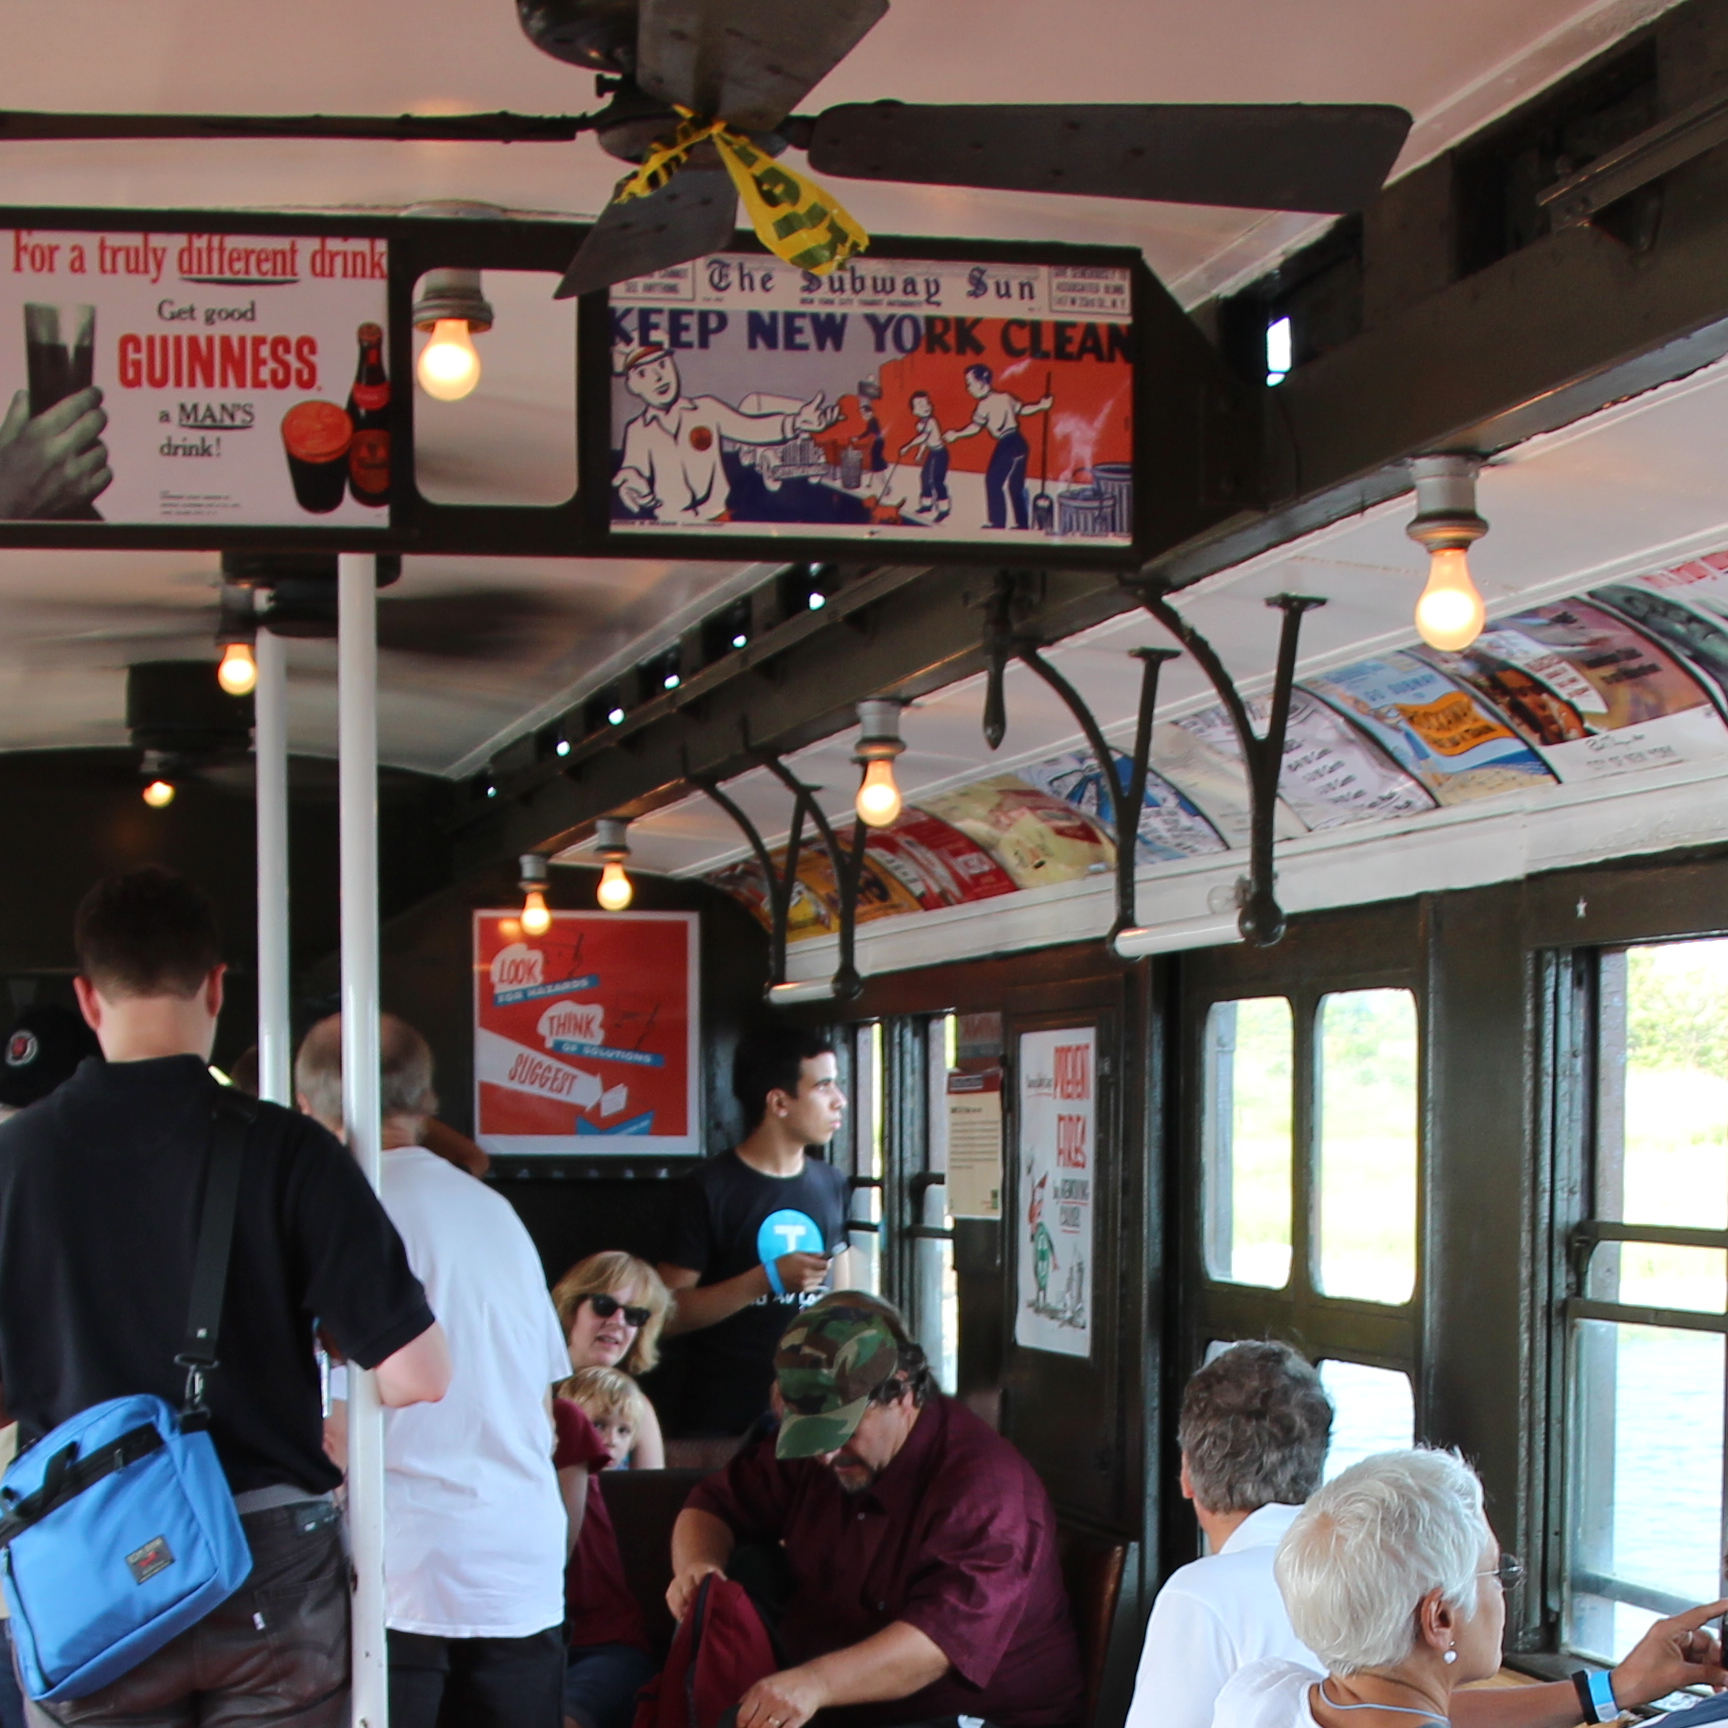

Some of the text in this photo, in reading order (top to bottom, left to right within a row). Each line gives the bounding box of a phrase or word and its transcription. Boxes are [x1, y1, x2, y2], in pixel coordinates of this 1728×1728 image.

[12, 230, 387, 283] For a truly different drink
[706, 258, 774, 292] The
[967, 266, 1035, 300] Sun
[157, 298, 257, 325] Get good
[610, 306, 1133, 364] KEEP NEW YORK CLEAN
[118, 333, 318, 390] GUINNESS
[159, 402, 255, 424] a MAN'S
[160, 437, 221, 457] drink!
[499, 958, 539, 984] LOOK
[497, 978, 589, 1003] FOR HAZARDS
[549, 1012, 596, 1037] THINK
[562, 1043, 652, 1063] OF SOLUTIONS
[508, 1053, 578, 1094] SUGGEST
[774, 1225, 806, 1251] T
